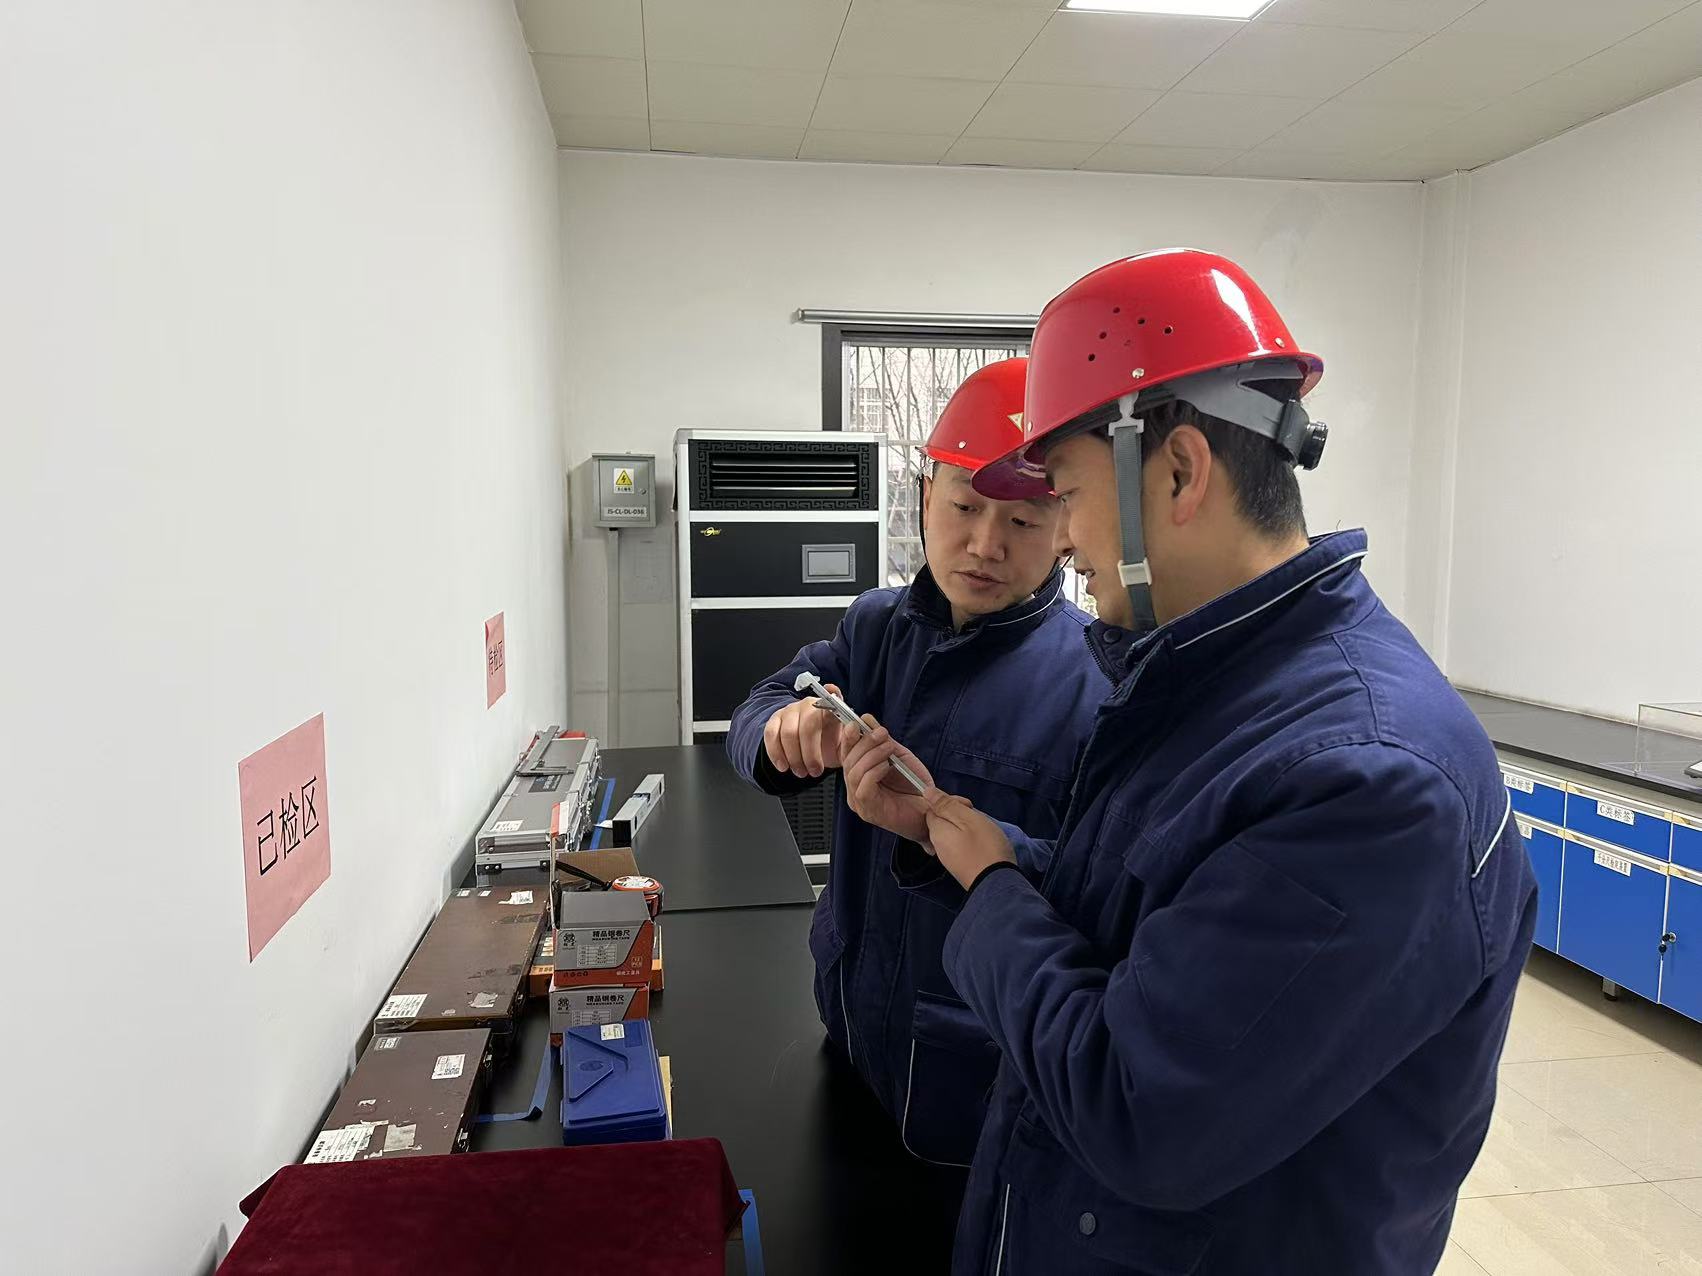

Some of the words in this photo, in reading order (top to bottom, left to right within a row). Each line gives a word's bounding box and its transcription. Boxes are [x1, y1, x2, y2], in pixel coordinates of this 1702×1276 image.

[257, 776, 319, 875] 已检区
[1599, 804, 1631, 822] C类标签
